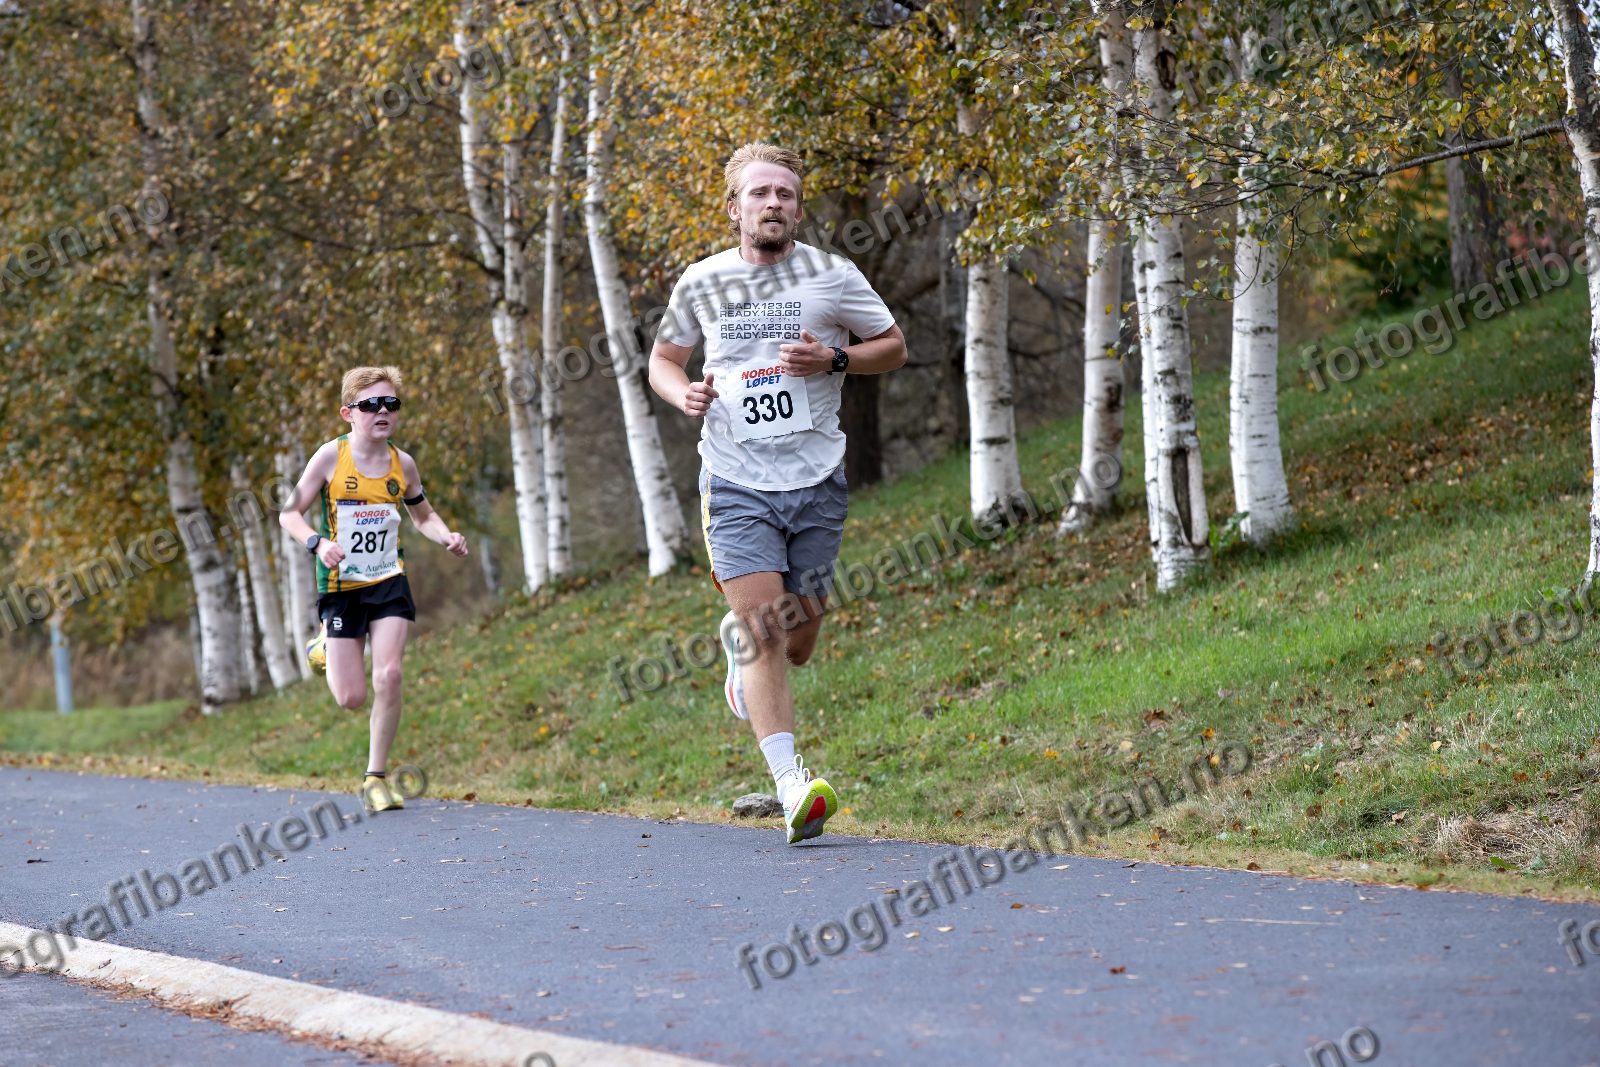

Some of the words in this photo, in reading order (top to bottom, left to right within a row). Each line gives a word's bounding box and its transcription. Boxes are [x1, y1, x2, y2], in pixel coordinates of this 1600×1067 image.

[720, 302, 801, 310] READY.123.GO
[746, 375, 782, 388] LØPET
[743, 390, 793, 425] 330
[353, 510, 391, 518] NORGES
[351, 529, 388, 554] 287
